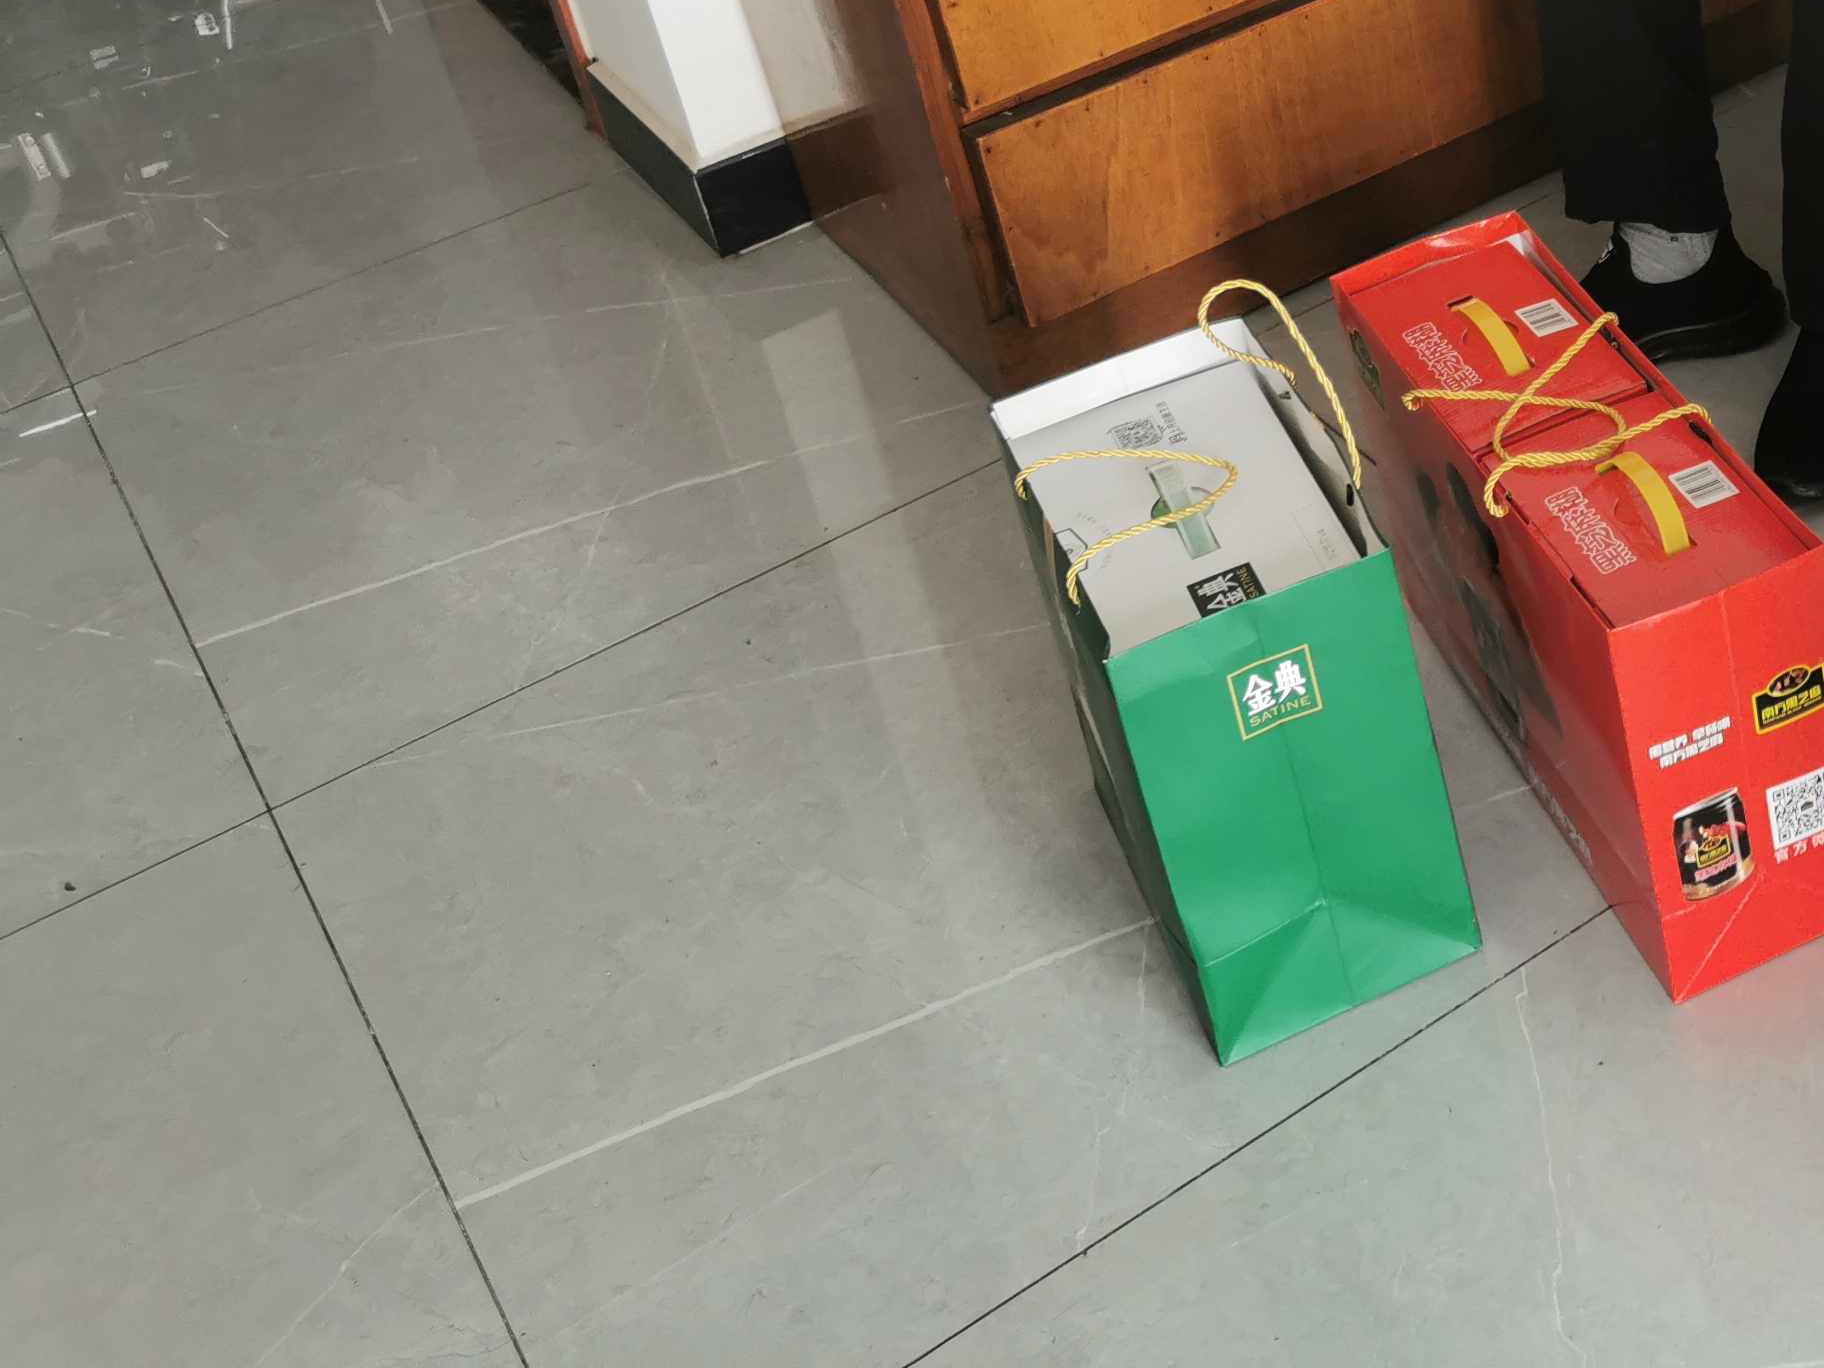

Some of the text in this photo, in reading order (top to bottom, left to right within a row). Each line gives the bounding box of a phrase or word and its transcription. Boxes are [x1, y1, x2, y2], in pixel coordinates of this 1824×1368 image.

[1236, 567, 1259, 599] SATINE
[1242, 660, 1307, 717] 金典
[1249, 695, 1311, 727] SATINE
